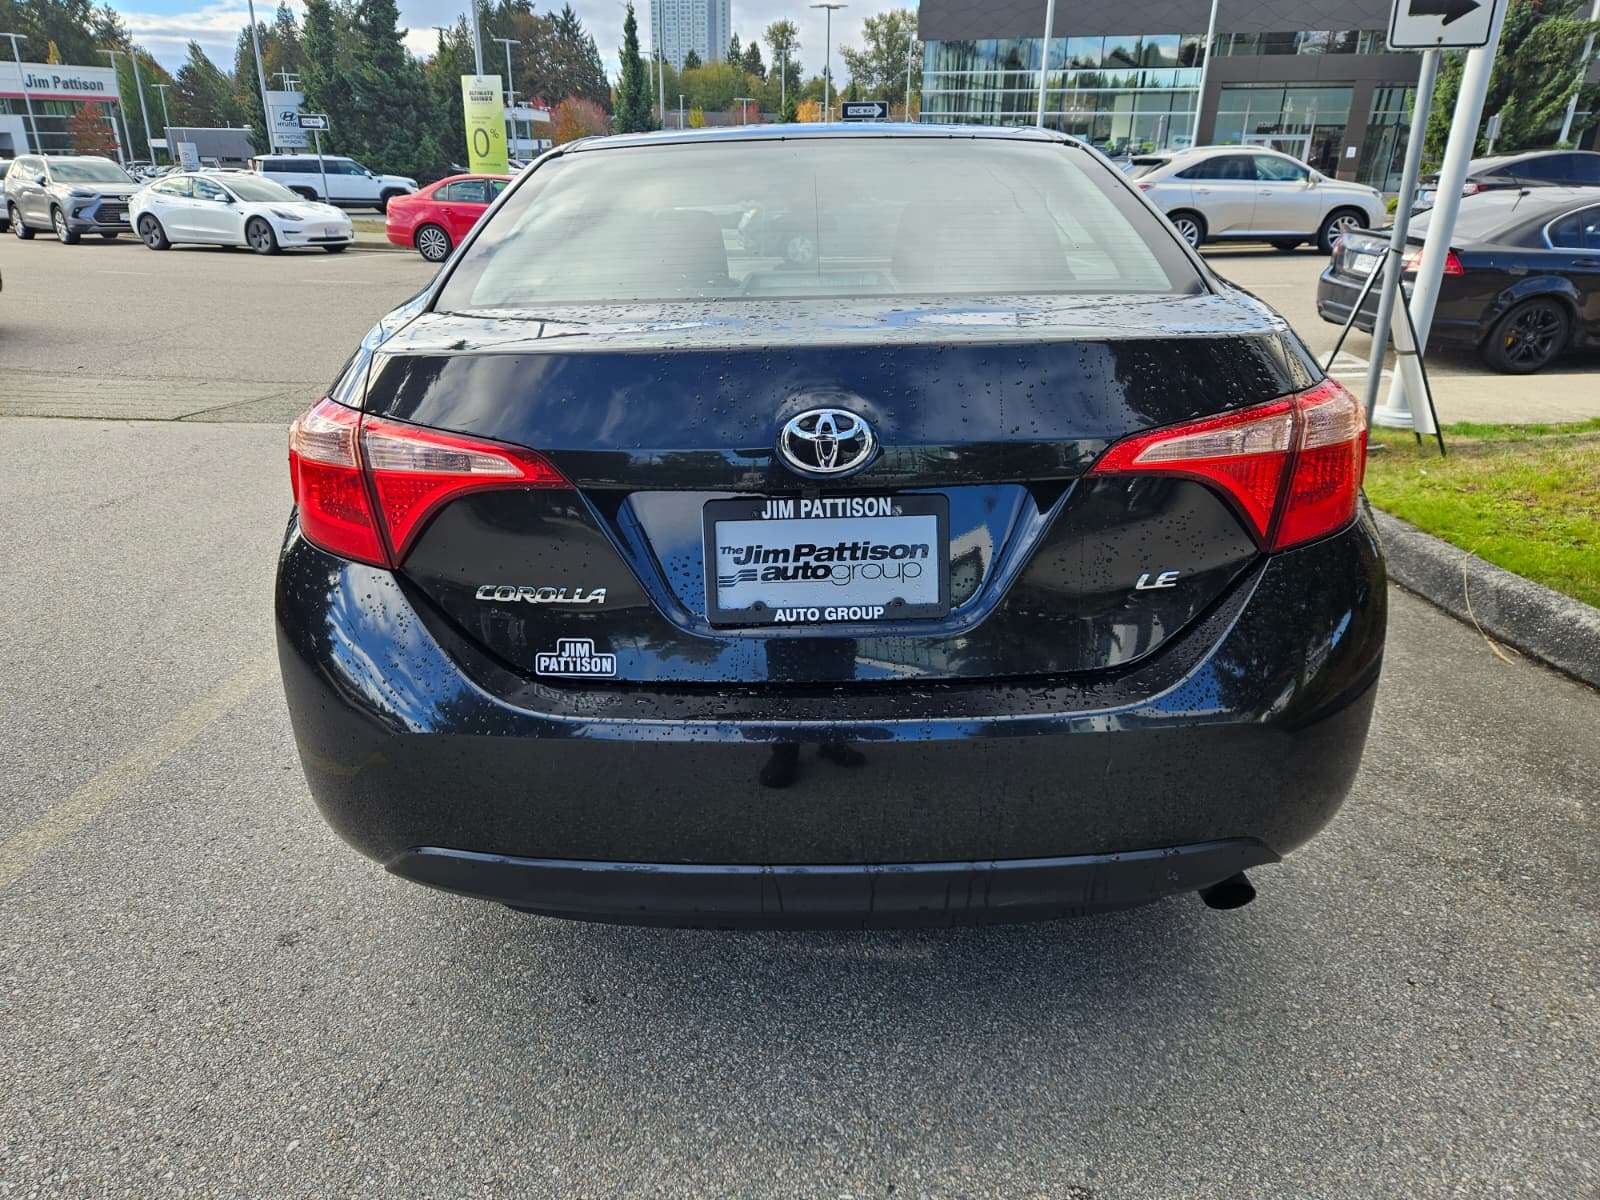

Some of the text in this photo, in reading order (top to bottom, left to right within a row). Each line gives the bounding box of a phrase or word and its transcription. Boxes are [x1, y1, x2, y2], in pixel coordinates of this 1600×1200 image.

[25, 74, 104, 91] Jim Pattison
[761, 496, 892, 520] JIM PATTISON
[719, 540, 929, 566] The Jim Pattison
[1135, 570, 1180, 590] LE
[475, 584, 607, 604] COROLLA
[774, 606, 885, 622] AUTO GROUP
[561, 642, 590, 658] JIM
[539, 656, 613, 673] PATTISON
